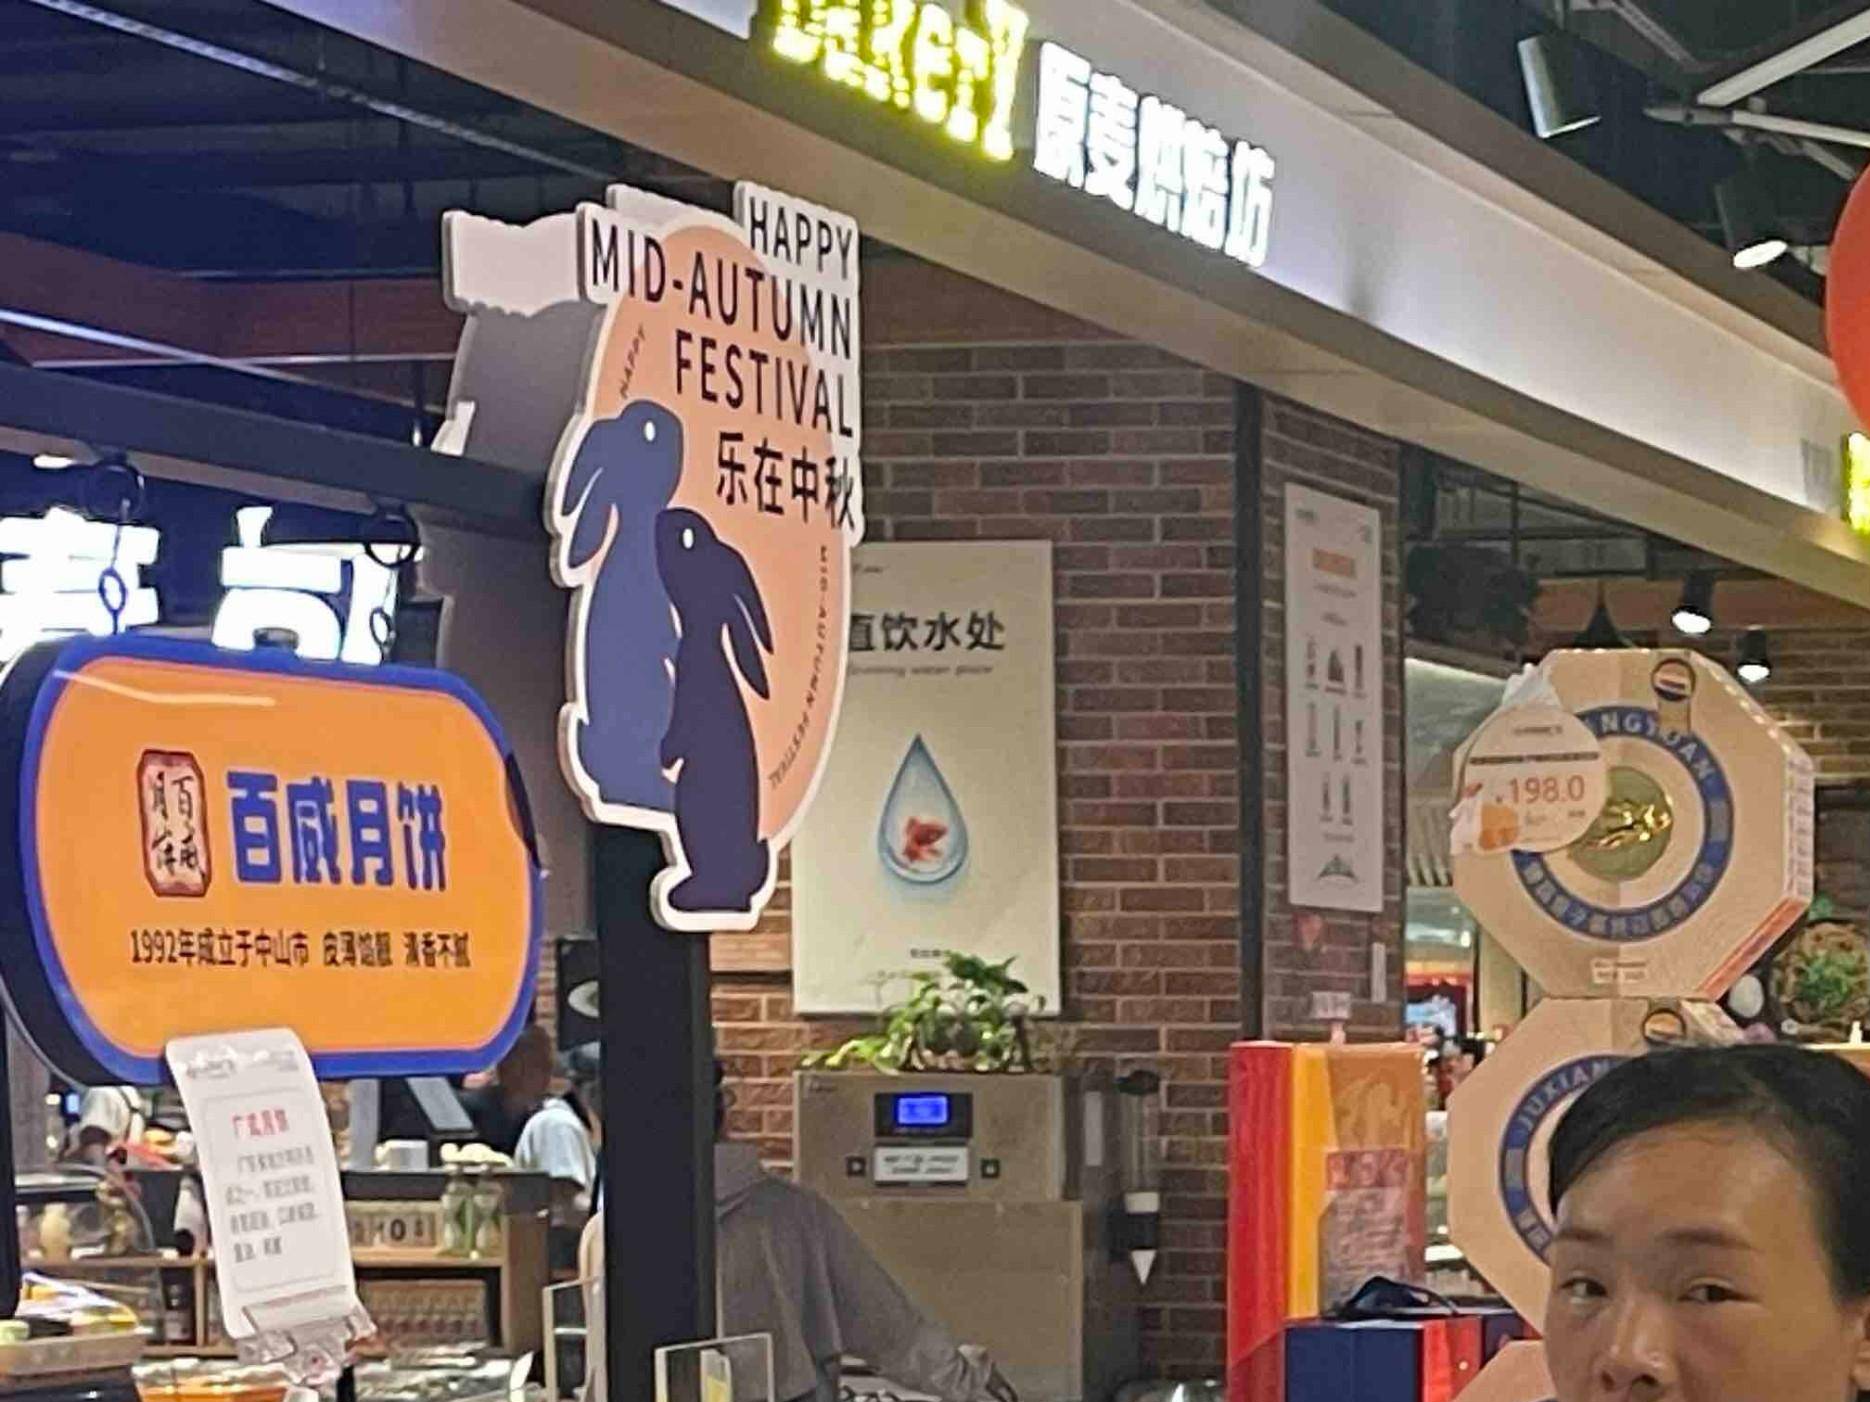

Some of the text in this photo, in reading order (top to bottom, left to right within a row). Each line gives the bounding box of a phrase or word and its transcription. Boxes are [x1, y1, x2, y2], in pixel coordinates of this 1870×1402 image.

[592, 219, 851, 360] MID-AUTUMN
[750, 197, 851, 279] HAPPY
[675, 329, 852, 438] FESTIVAL
[717, 432, 855, 529] 乐在中秋
[227, 771, 447, 891] 百威月饼
